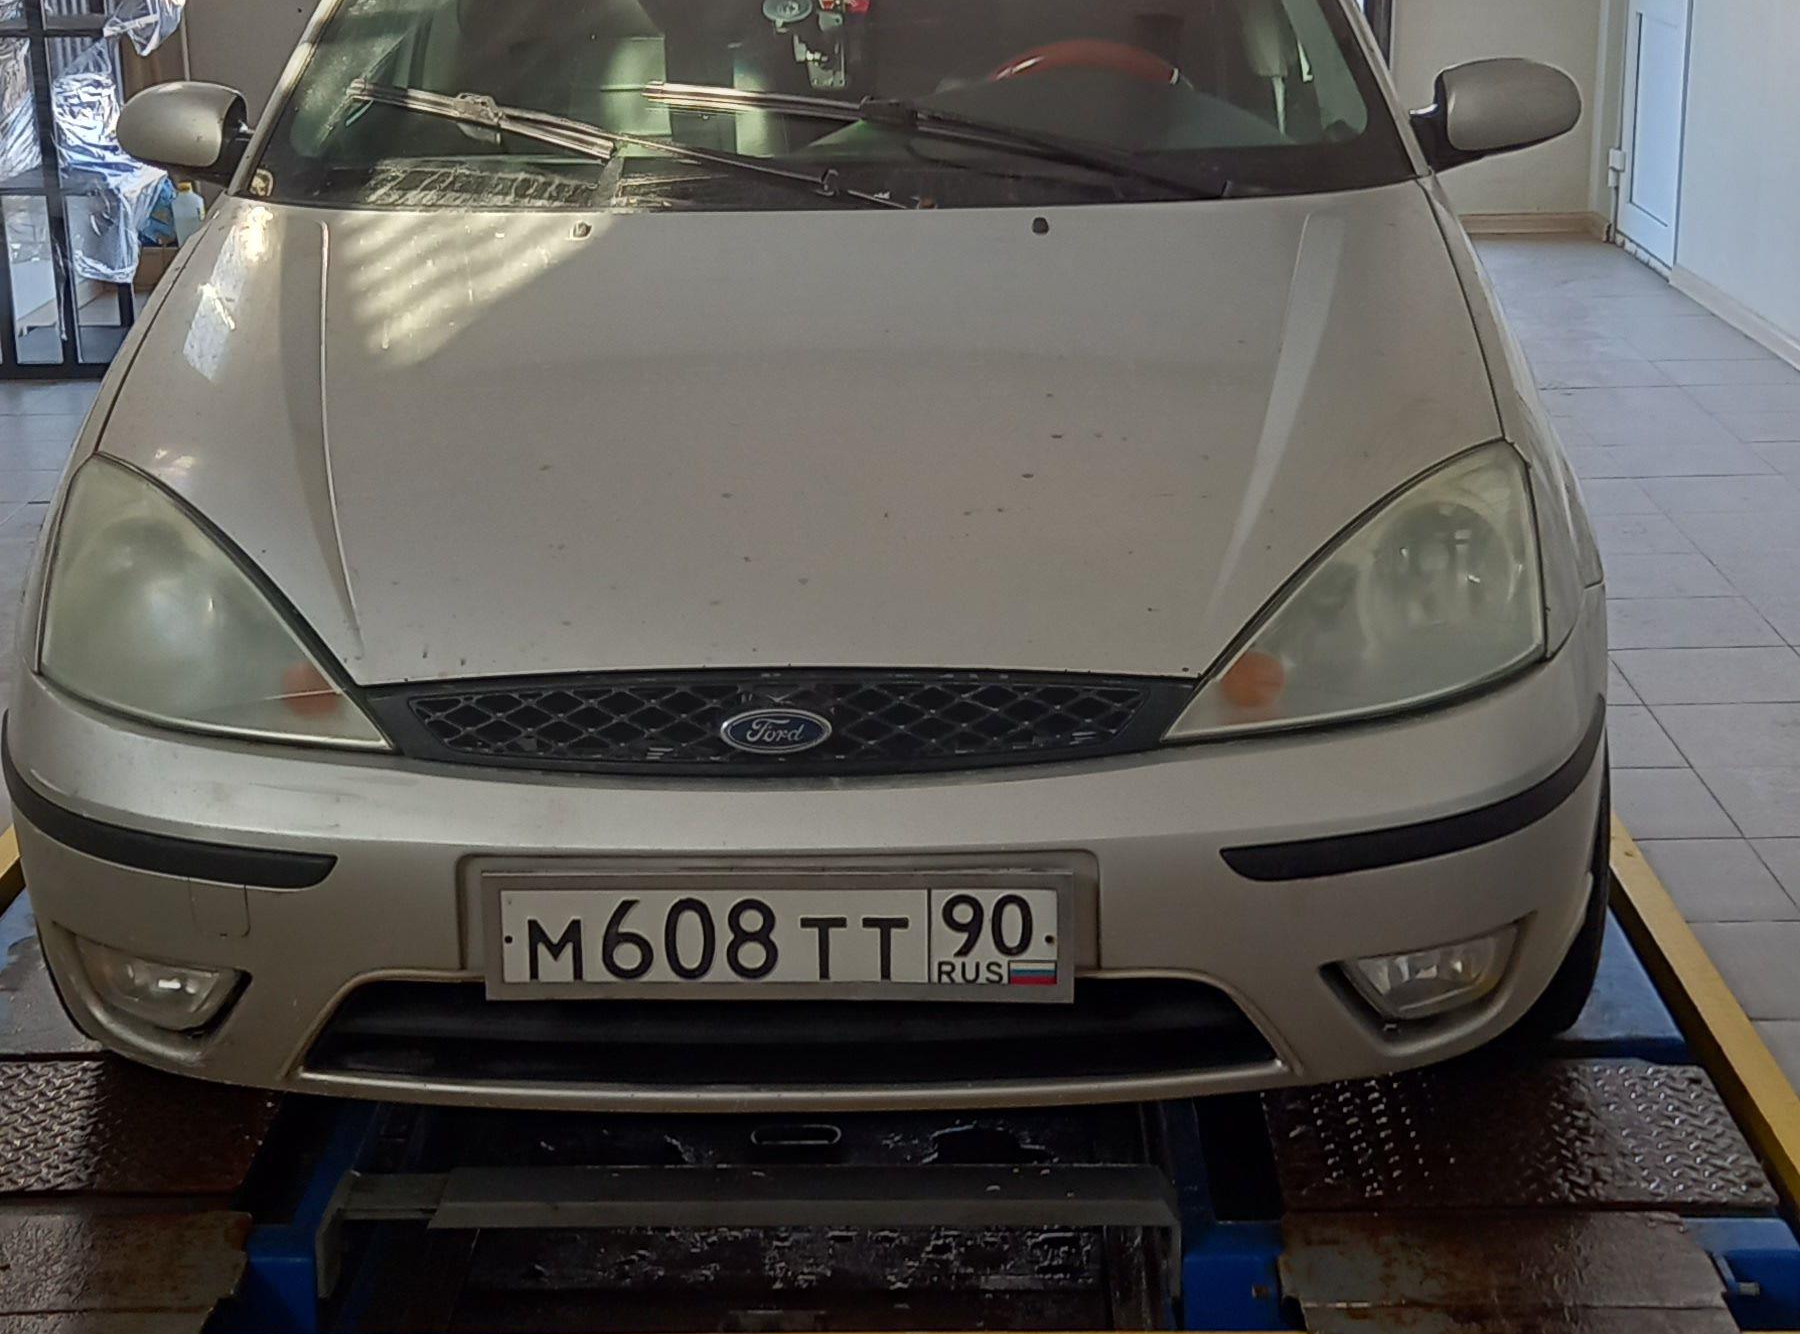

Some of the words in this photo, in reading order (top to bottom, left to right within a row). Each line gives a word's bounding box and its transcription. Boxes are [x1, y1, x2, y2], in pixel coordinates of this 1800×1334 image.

[746, 718, 805, 742] Ford
[941, 893, 1034, 957] 90
[937, 961, 1003, 985] RUS
